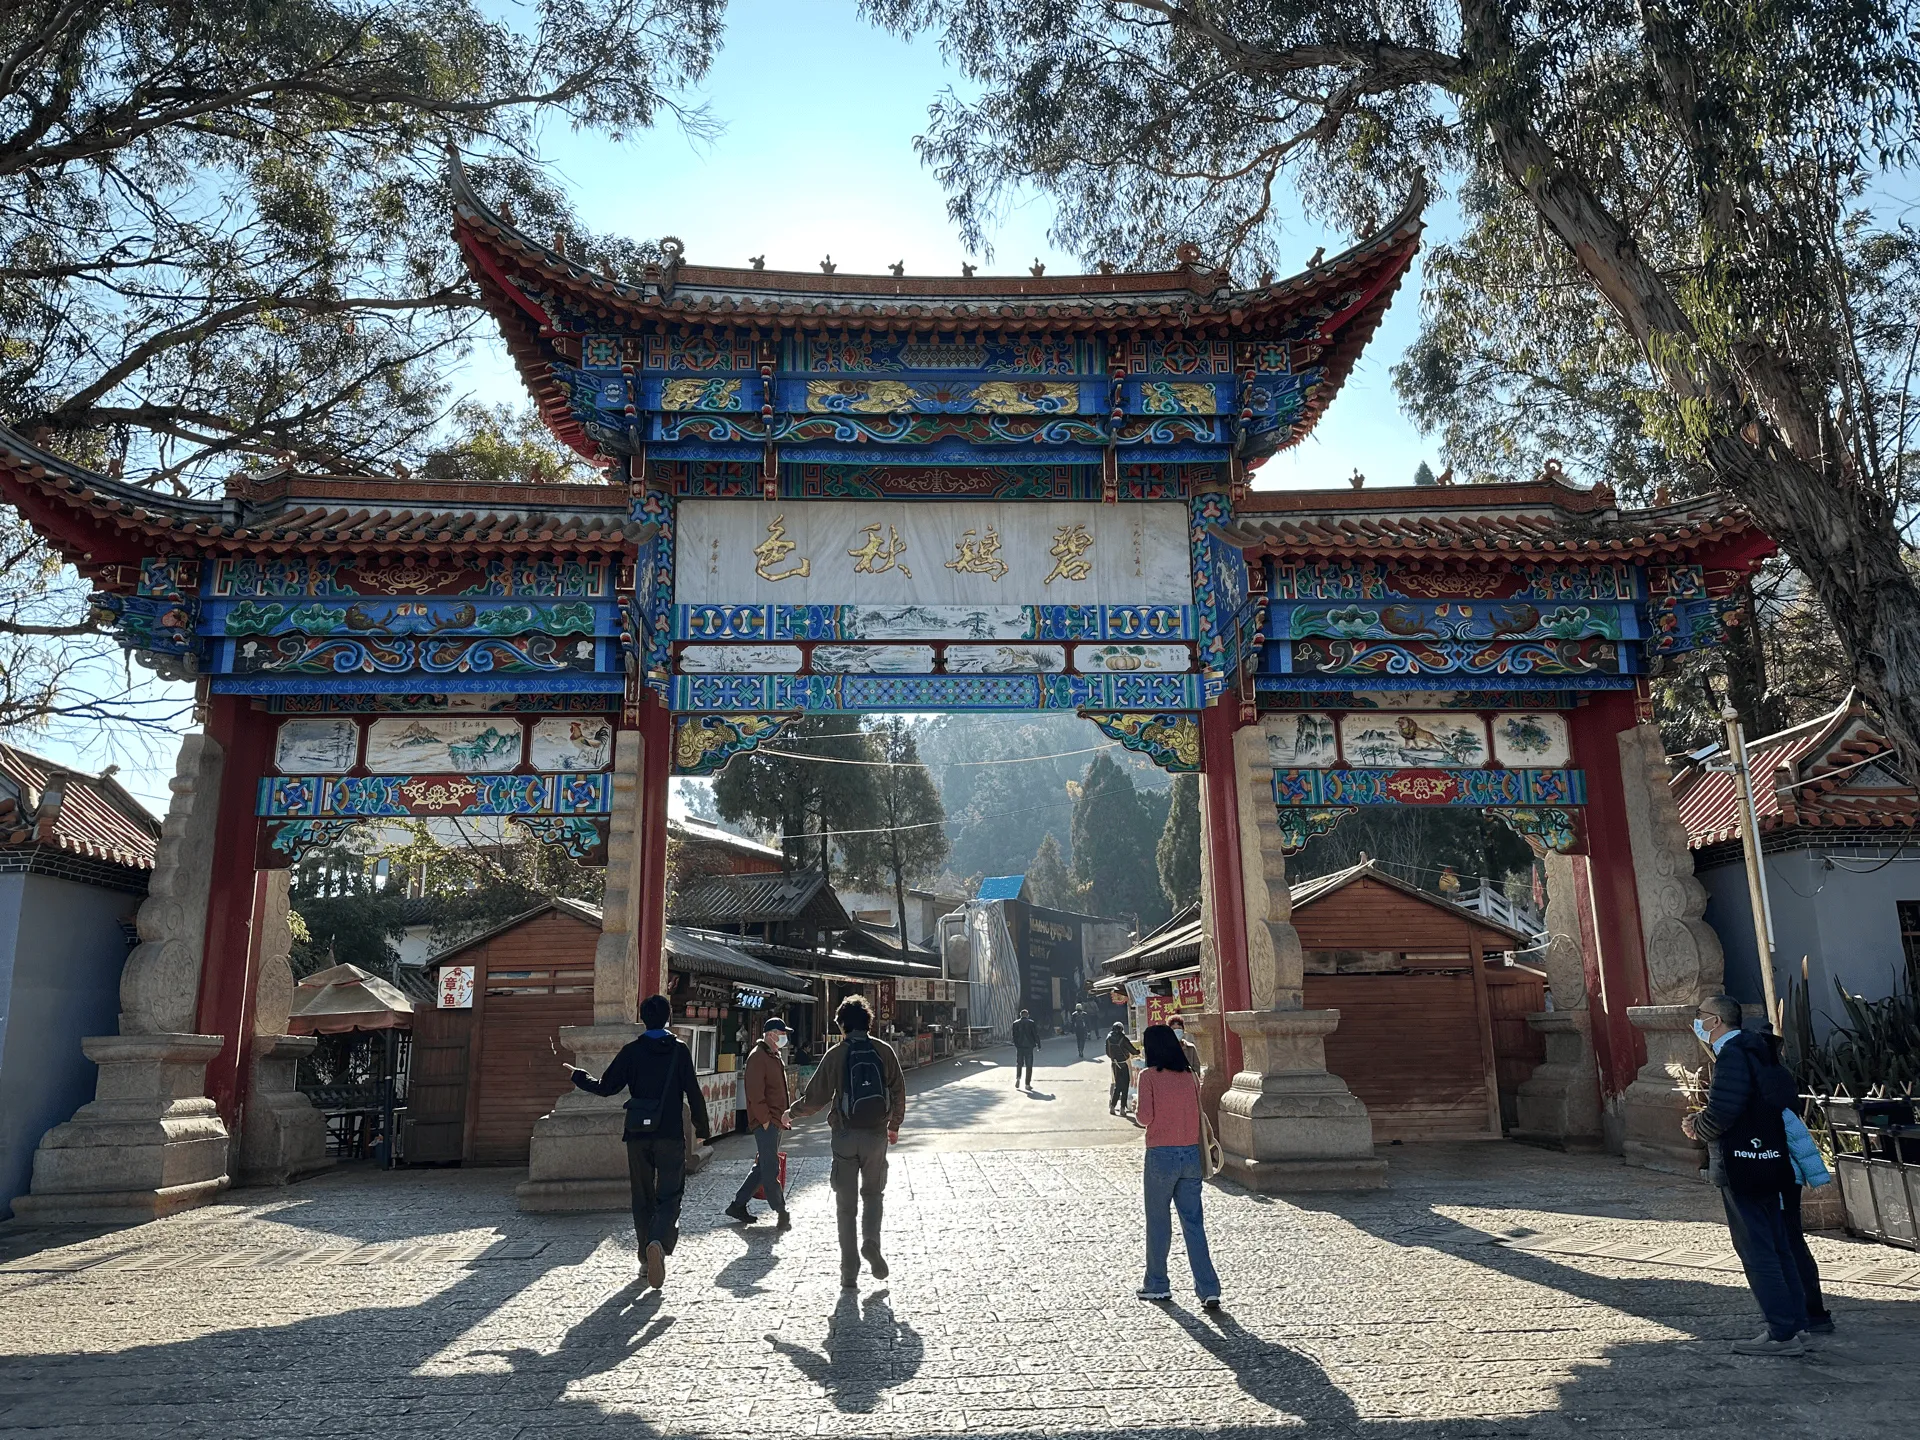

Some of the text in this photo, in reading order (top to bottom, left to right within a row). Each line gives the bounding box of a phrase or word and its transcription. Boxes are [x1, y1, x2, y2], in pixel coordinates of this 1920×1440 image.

[444, 977, 457, 1007] 章鱼
[458, 976, 466, 1000] 小丸子
[1150, 998, 1162, 1025] 木瓜
[1734, 1150, 1757, 1159] new
